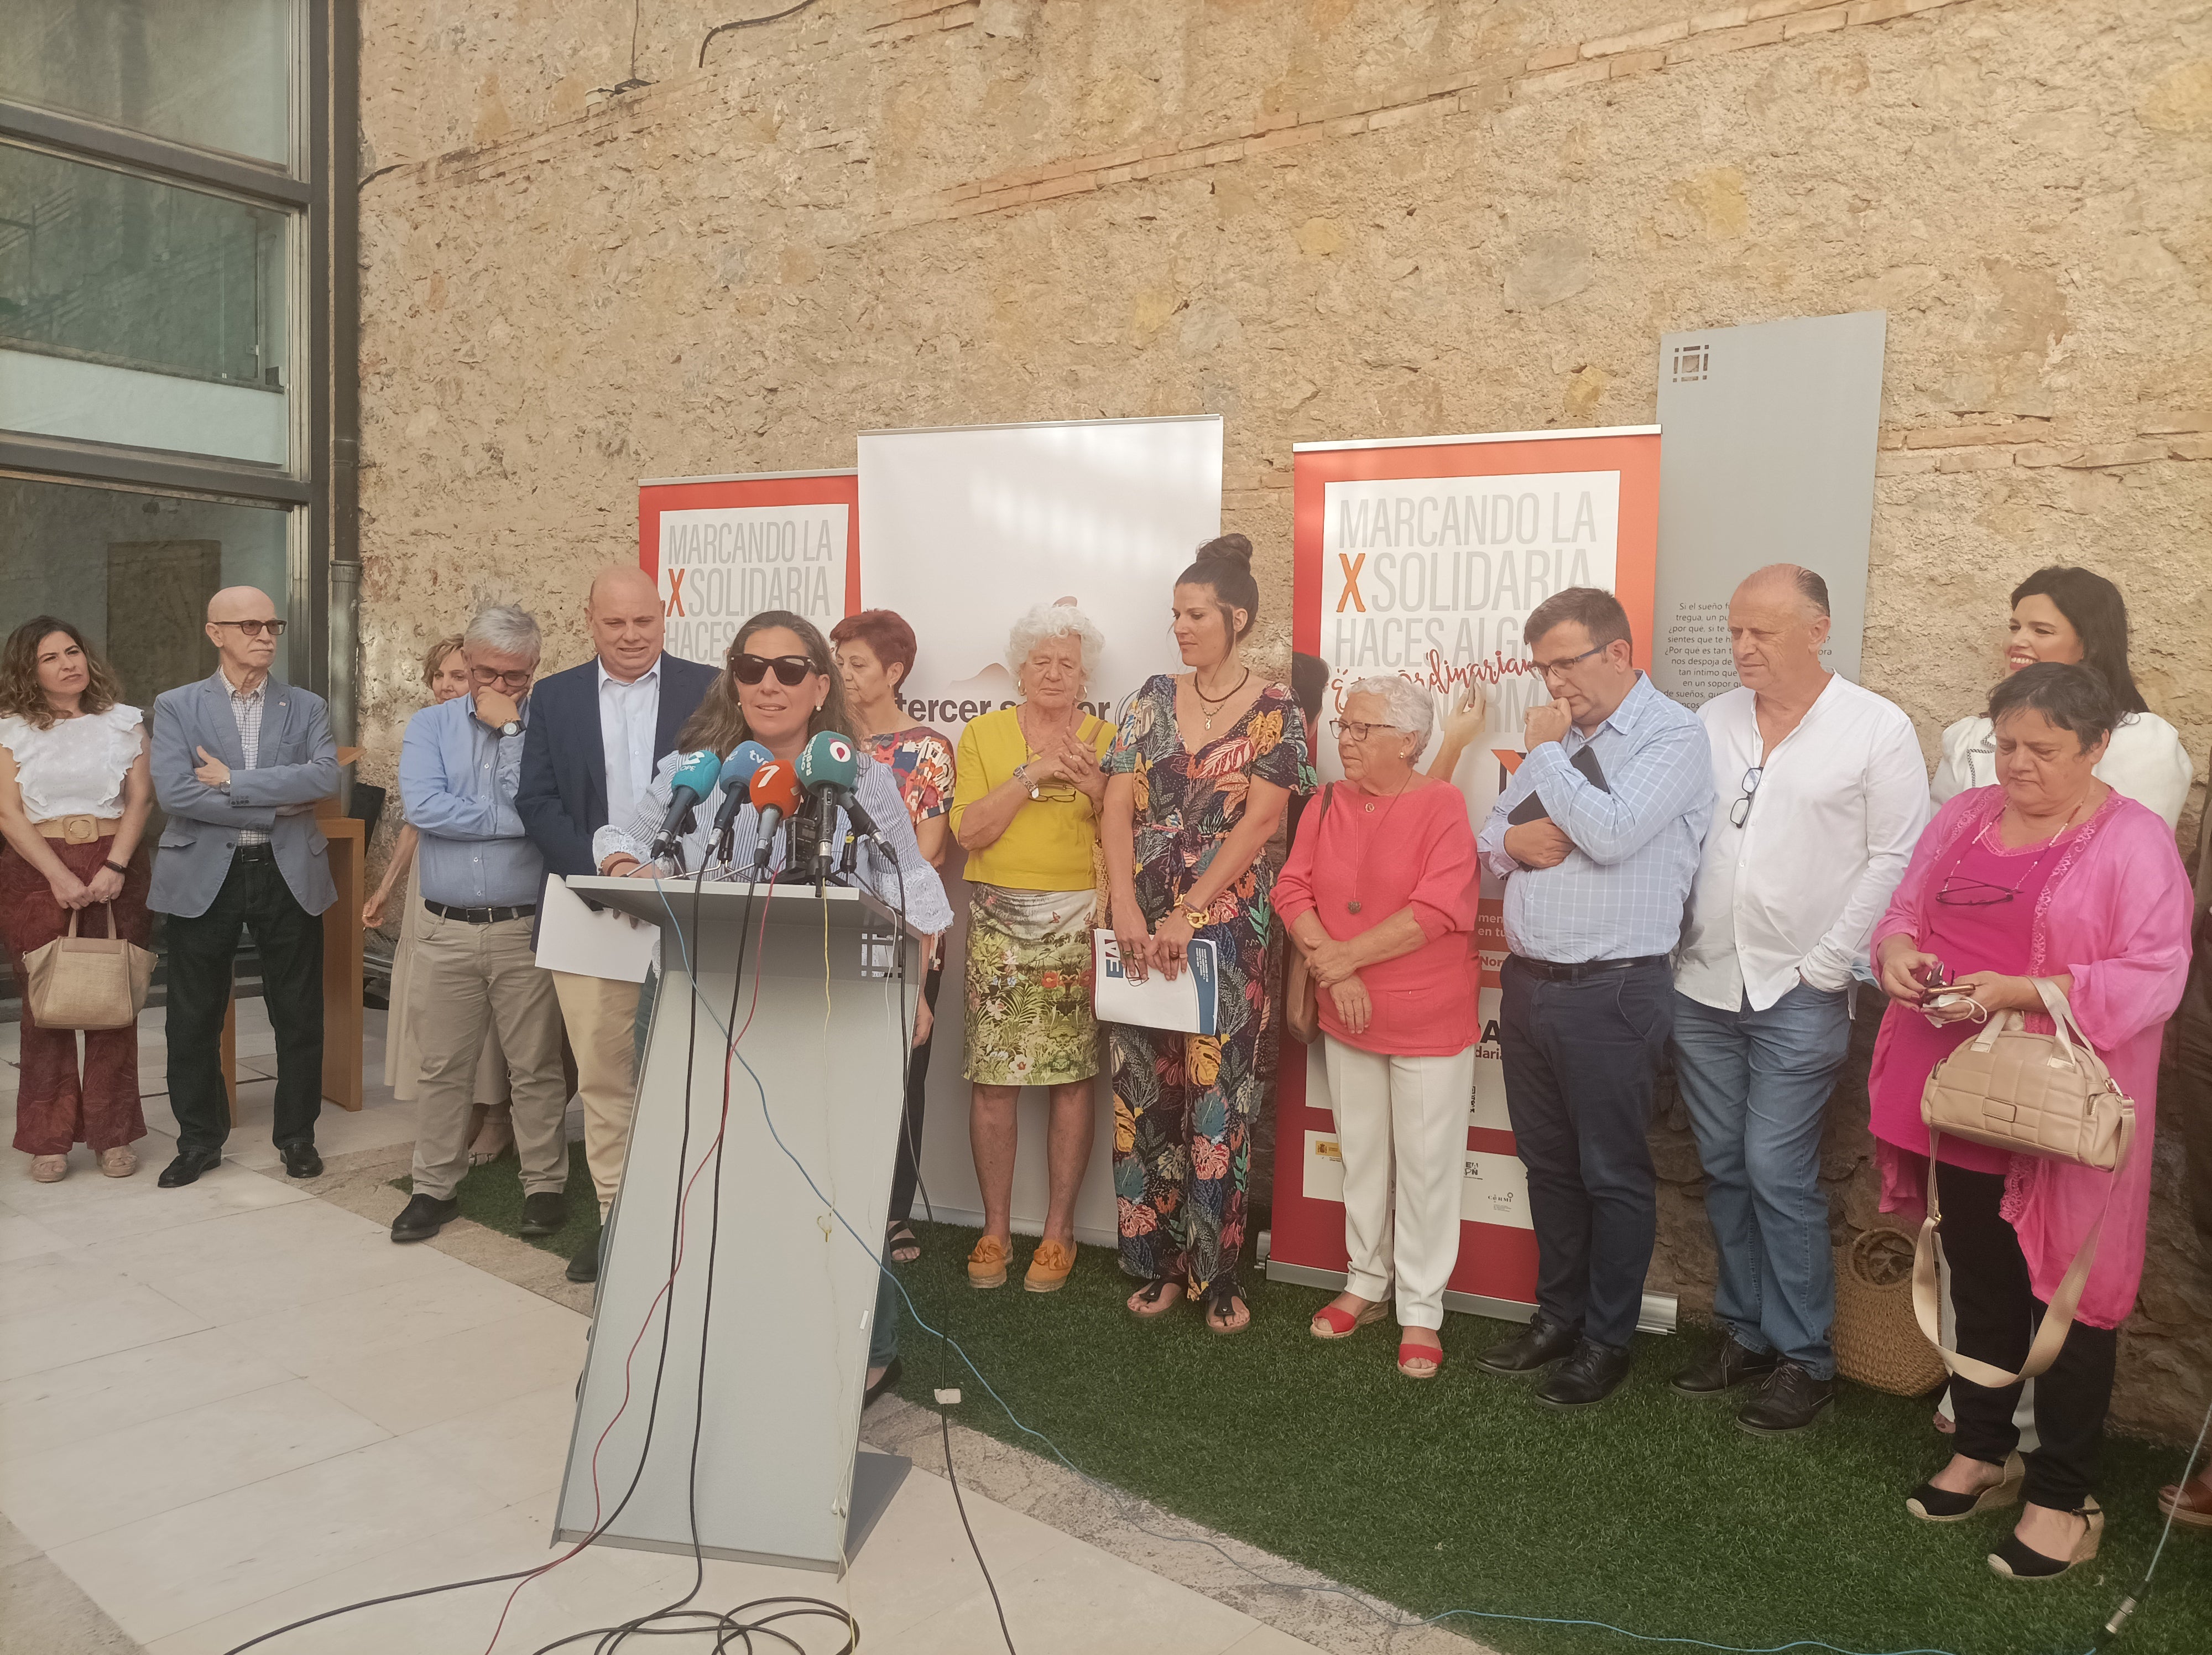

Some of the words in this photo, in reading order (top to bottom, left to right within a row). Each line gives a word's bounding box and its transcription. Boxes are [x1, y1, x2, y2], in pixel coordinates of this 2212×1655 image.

[1338, 492, 1540, 548] MARCANDO
[1552, 491, 1597, 544] LA
[667, 521, 796, 565] MARCANDO
[803, 519, 832, 562] LA
[666, 568, 686, 617] X
[688, 566, 831, 617] SOLIDARIA
[1335, 553, 1366, 612] X
[1371, 548, 1592, 612] SOLIDARIA
[1668, 626, 1686, 634] ¿por
[1676, 615, 1703, 623] tregua,
[1335, 617, 1444, 668] HACES
[1665, 646, 1683, 655] ¿Por
[1684, 646, 1700, 655] qué
[1688, 657, 1719, 667] despoja
[1708, 680, 1731, 689] sopor
[895, 693, 992, 723] tercer
[758, 764, 780, 788] 7
[1478, 928, 1492, 936] en
